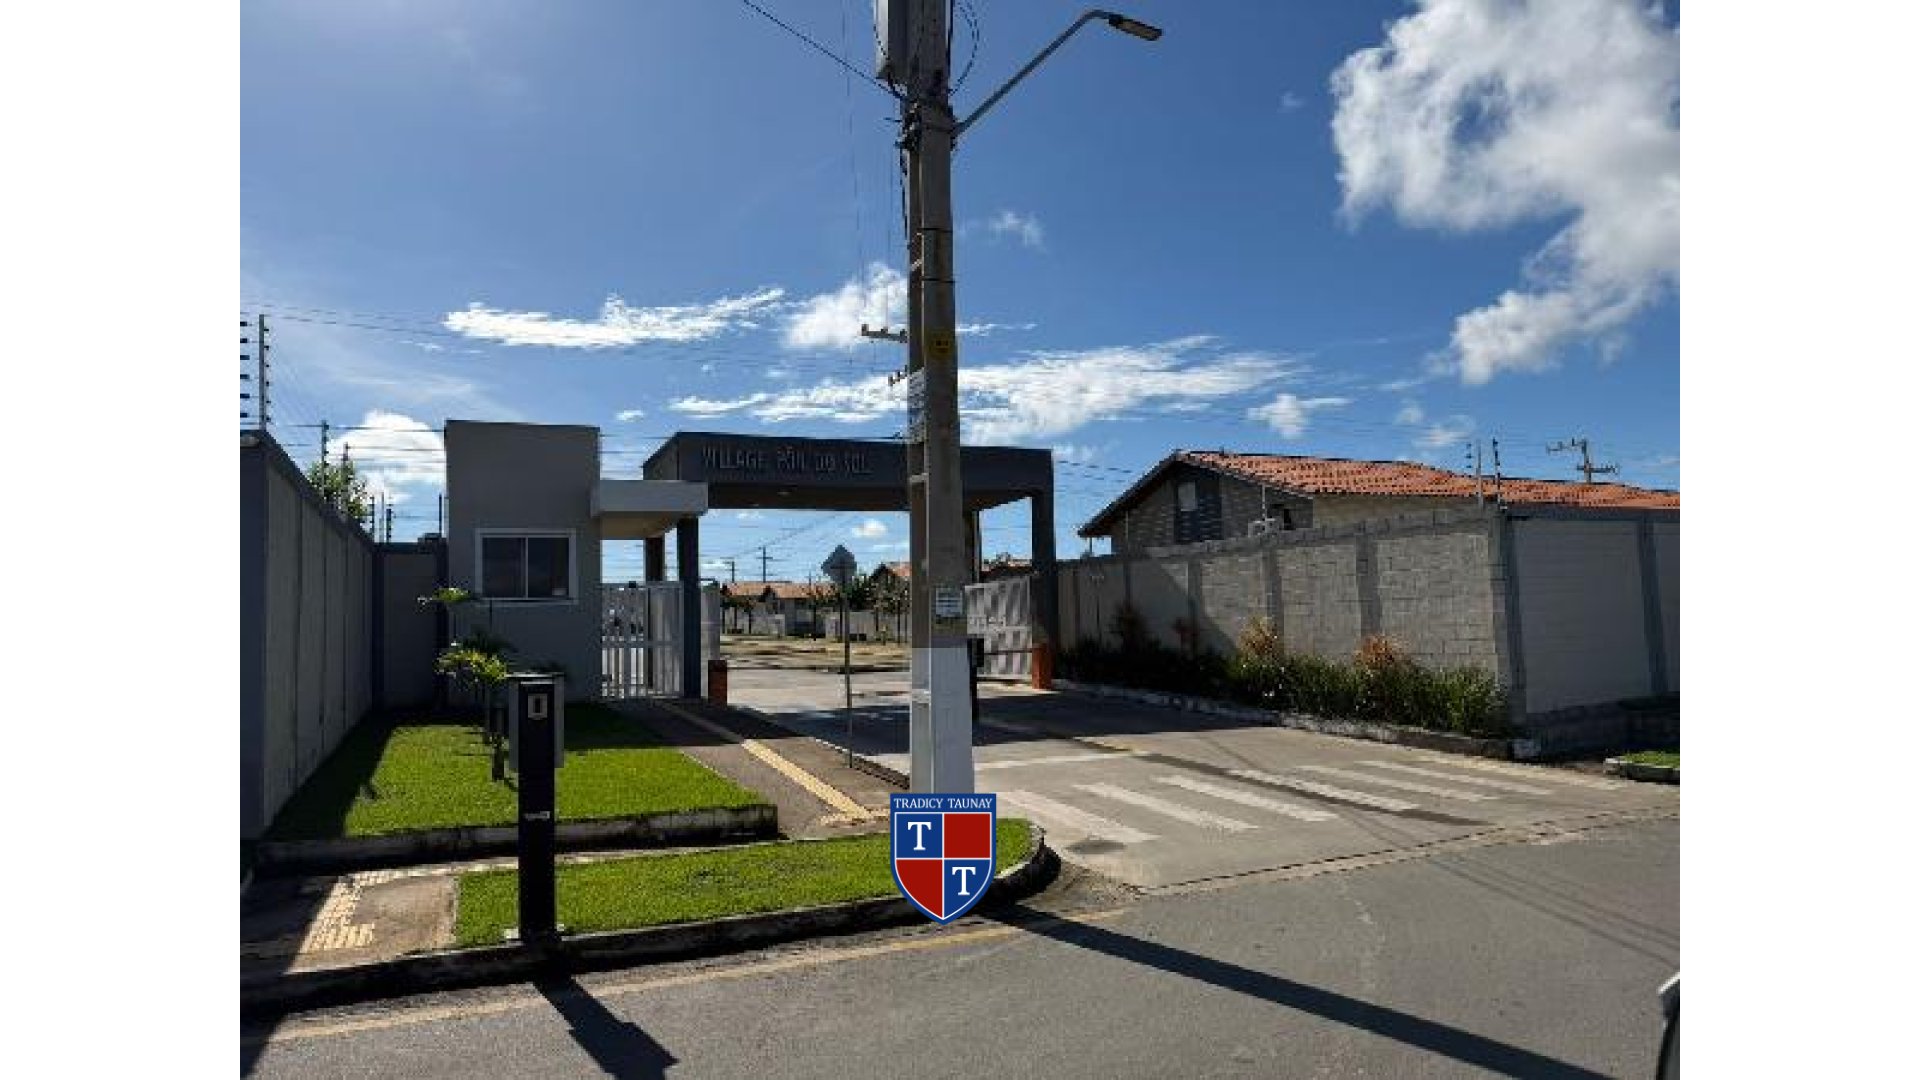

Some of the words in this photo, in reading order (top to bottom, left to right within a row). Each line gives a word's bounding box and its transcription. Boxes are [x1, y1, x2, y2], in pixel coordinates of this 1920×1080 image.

[702, 445, 768, 470] VILLAGE
[815, 452, 837, 473] DO
[843, 452, 873, 474] SOL
